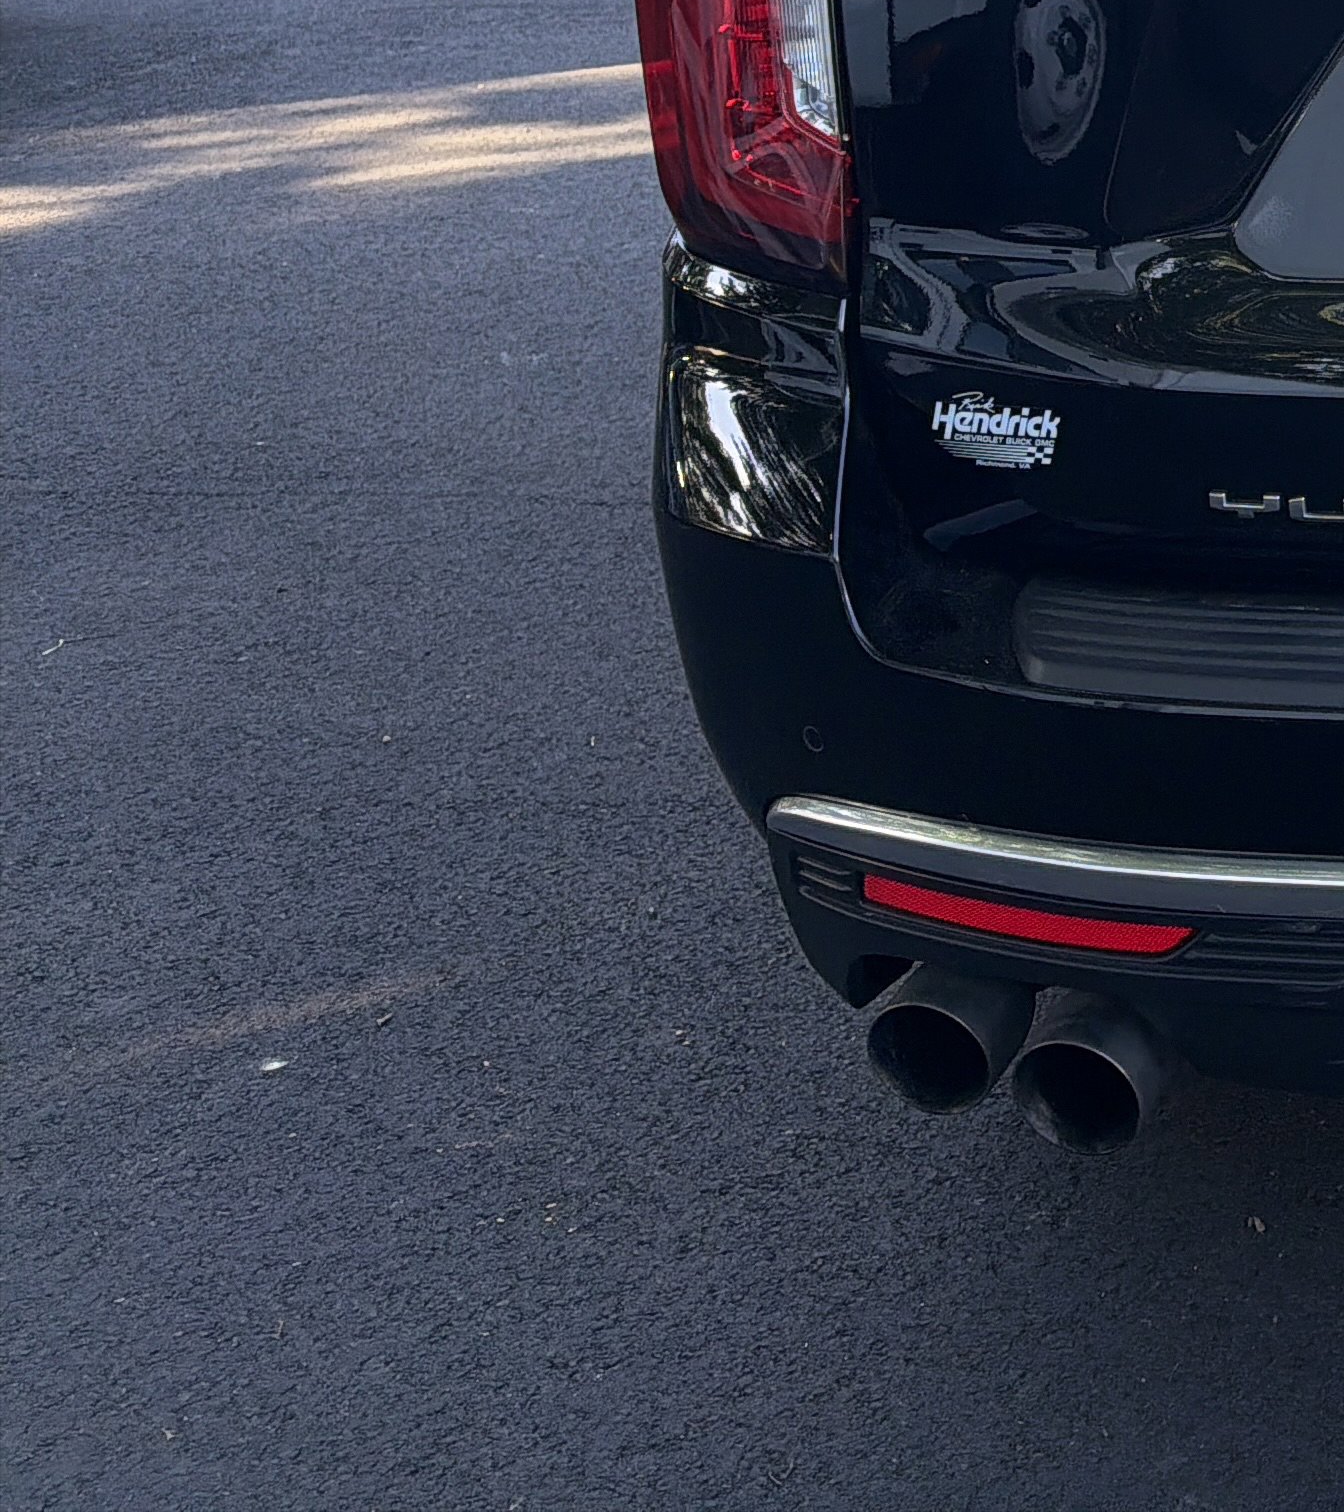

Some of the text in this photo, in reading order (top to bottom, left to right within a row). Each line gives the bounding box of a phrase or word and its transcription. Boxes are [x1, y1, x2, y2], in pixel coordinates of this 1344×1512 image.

[931, 401, 1061, 440] Hendrick
[954, 433, 1056, 448] CHEVROLET BUICK GMC
